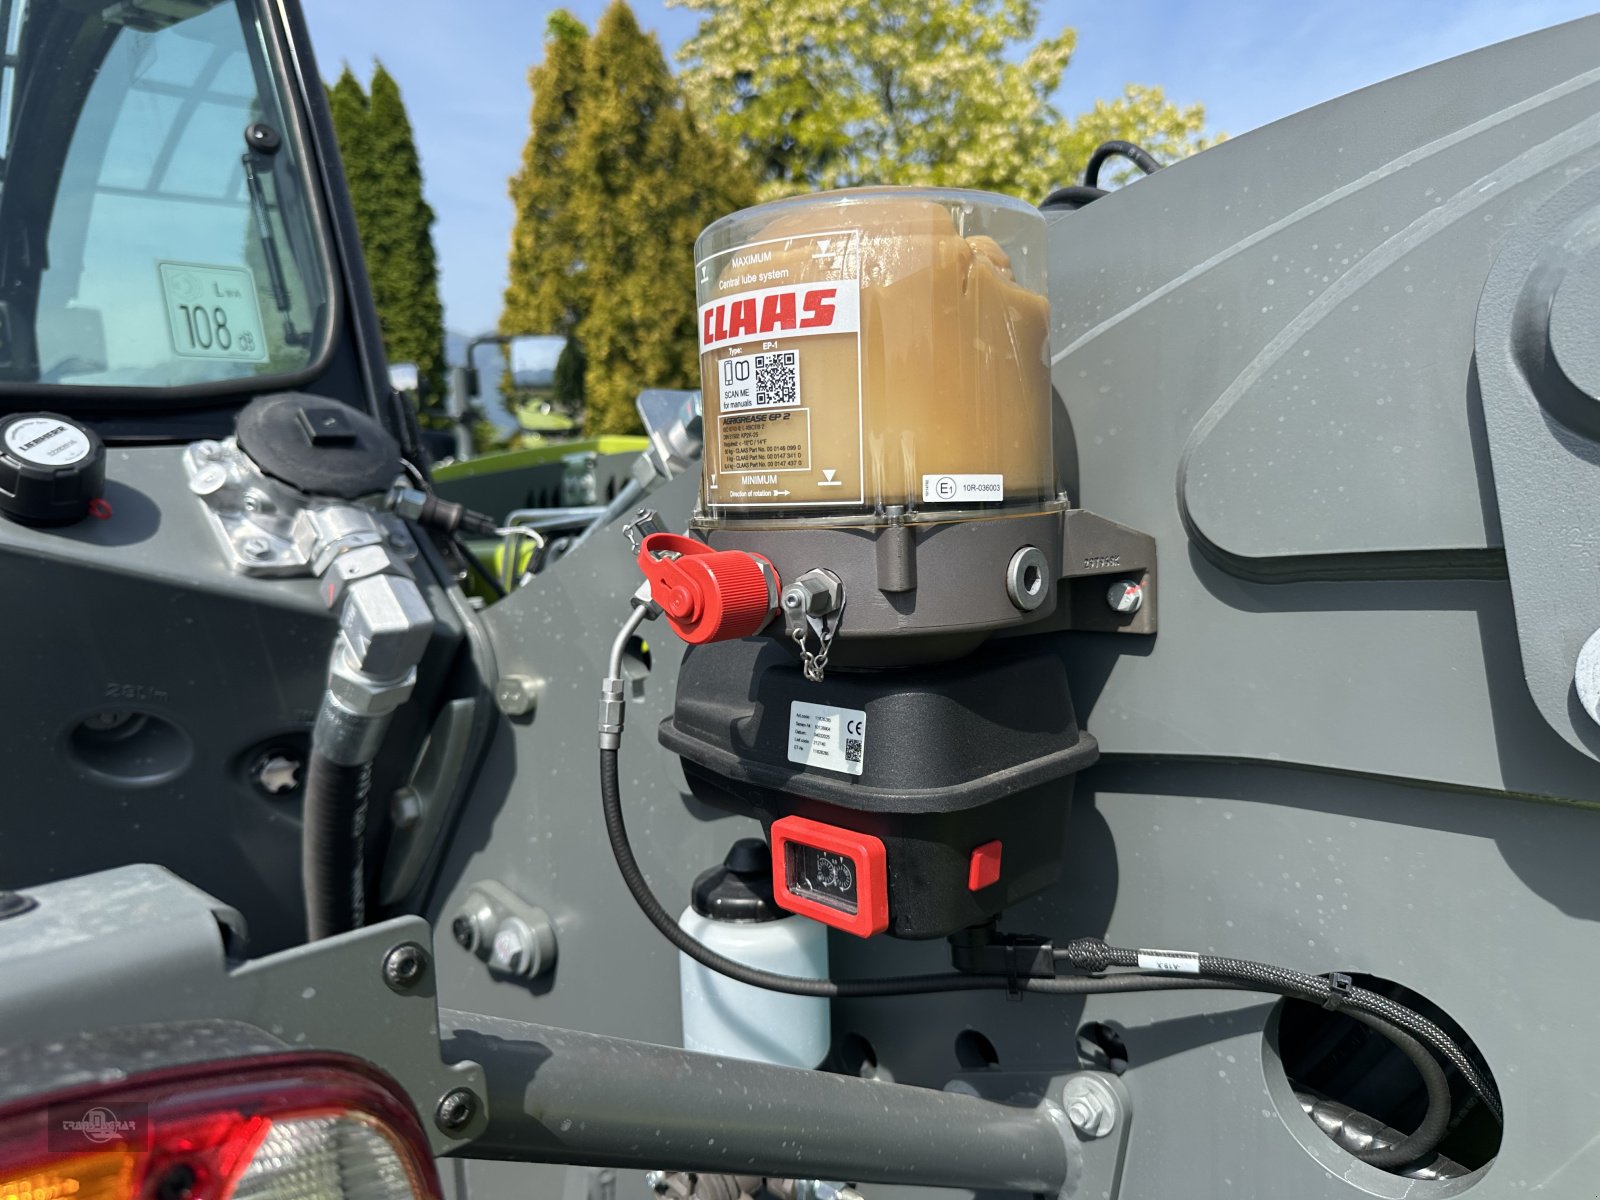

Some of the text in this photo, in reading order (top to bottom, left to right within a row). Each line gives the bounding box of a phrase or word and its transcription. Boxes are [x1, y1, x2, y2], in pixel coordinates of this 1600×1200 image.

[731, 252, 772, 268] MAXIMUM
[719, 269, 789, 290] Central lube system
[703, 288, 837, 345] CLAAS
[179, 305, 232, 350] 108
[728, 341, 777, 356] Type: EP-1
[725, 389, 749, 399] SCAN ME
[730, 399, 752, 409] manuals
[723, 414, 767, 425] AGRIGREASE
[769, 413, 781, 421] EP
[742, 475, 777, 485] MINIMUM
[963, 484, 1000, 492] 10R-036003
